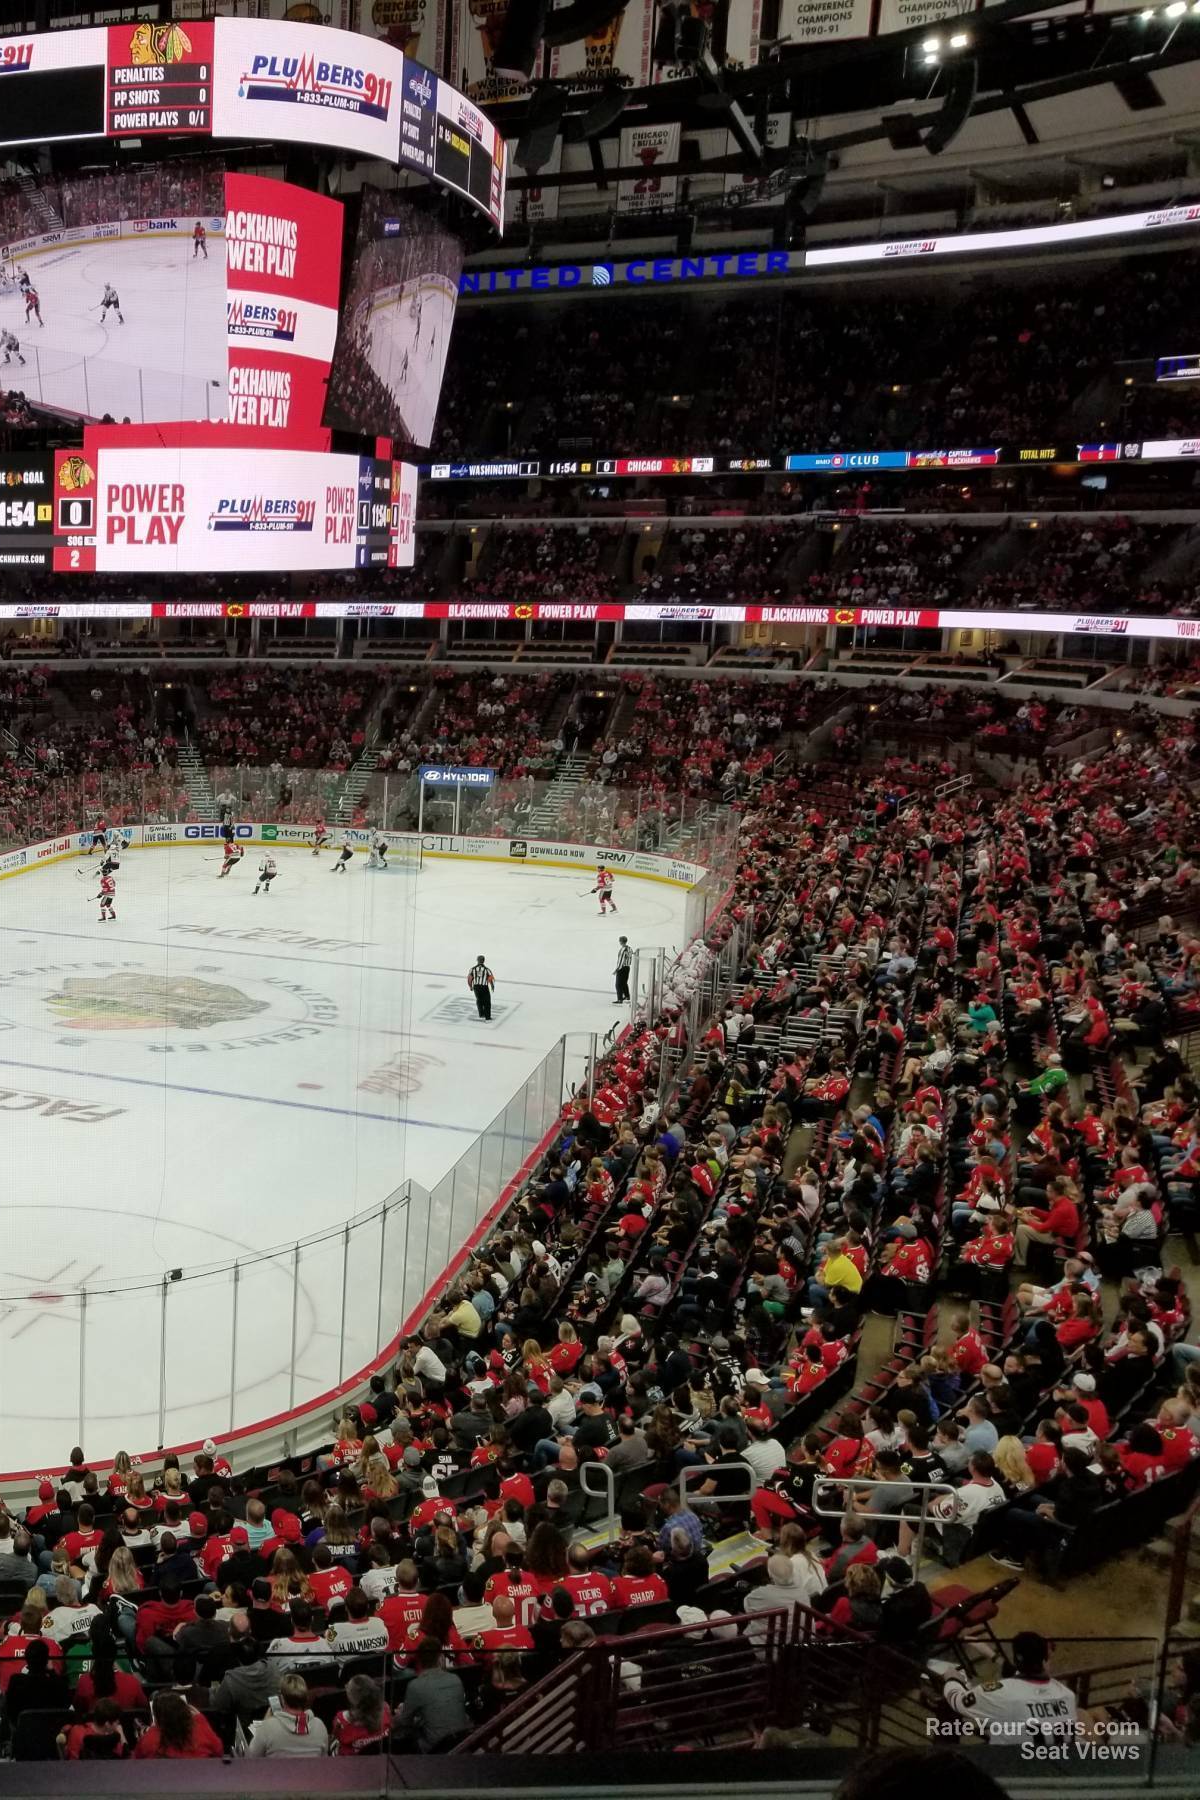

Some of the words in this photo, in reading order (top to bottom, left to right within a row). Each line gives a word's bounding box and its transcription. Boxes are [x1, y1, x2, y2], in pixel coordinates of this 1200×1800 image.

[797, 12, 852, 25] CHAMPIONS
[800, 24, 840, 36] 1990-91
[114, 67, 164, 84] PENALTIES
[199, 68, 207, 80] 0
[114, 91, 127, 107] PP
[128, 89, 160, 105] SHOTS
[199, 88, 206, 103] 0
[296, 91, 360, 112] 1-833-PLUM-911
[114, 113, 148, 129] POWER
[149, 111, 179, 127] PLAYS
[632, 131, 669, 140] CHICAGO
[267, 246, 297, 279] PLAY
[626, 252, 790, 284] CENTER
[260, 396, 291, 428] PLAY
[850, 455, 880, 466] CLUB
[948, 449, 973, 458] CAPITALS
[1020, 450, 1039, 460] TOTAL
[1039, 448, 1056, 459] HITS
[550, 462, 577, 474] 11:54
[603, 461, 610, 473] 0
[627, 460, 663, 473] CHICAGO
[947, 456, 982, 466] BLACKHAWKS
[469, 463, 519, 476] WASHINGTON
[23, 471, 45, 484] GOAL
[107, 484, 185, 513] POWER
[325, 486, 355, 514] POWER
[69, 503, 82, 525] 0
[106, 515, 186, 544] PLAY
[324, 515, 355, 544] PLAY
[67, 536, 83, 546] SOG
[70, 551, 80, 568] 2
[165, 603, 223, 617] BLACKHAWKS
[249, 603, 280, 617] POWER
[280, 603, 304, 617] PLAY
[448, 603, 510, 618] BLACKHAWKS
[538, 605, 570, 619] POWER
[571, 605, 598, 619] PLAY
[761, 607, 829, 623] BLACKHAWKS
[860, 610, 895, 625] POWER
[896, 610, 921, 626] PLAY
[1176, 622, 1196, 636] YOUR
[144, 833, 157, 842] LIVE
[157, 832, 177, 841] GAMES
[421, 836, 459, 853] GTL
[530, 846, 568, 857] DOWNLOAD
[569, 849, 585, 858] NOW
[596, 851, 627, 863] SRM
[160, 923, 381, 952] FACE-OFF
[263, 976, 340, 1026] UNITED
[329, 1581, 349, 1595] KANE
[507, 1584, 533, 1598] SHARP
[577, 1588, 602, 1601] TOEWS
[629, 1591, 655, 1605] SHARP
[1026, 1700, 1069, 1718] TOEWS
